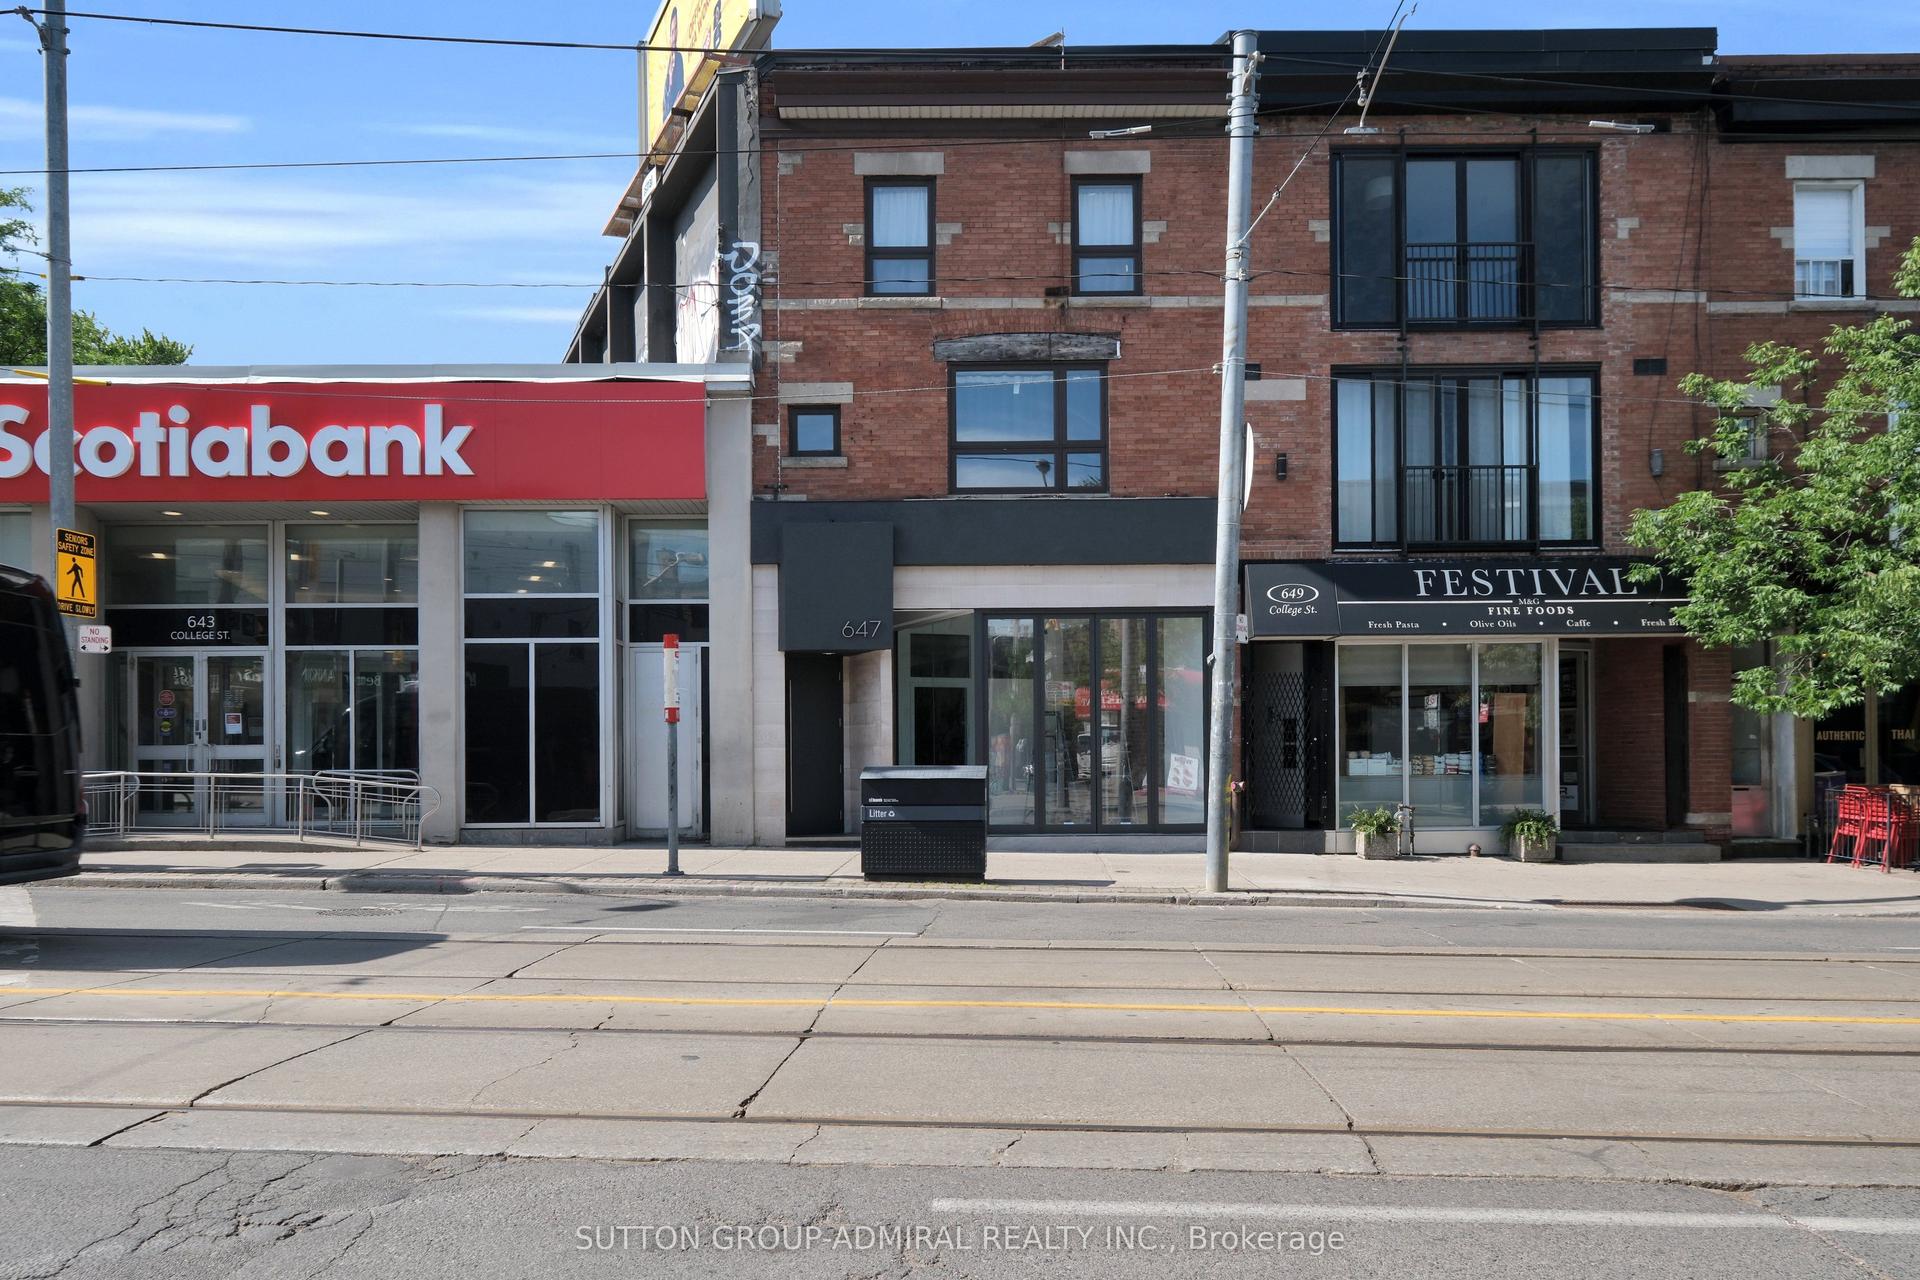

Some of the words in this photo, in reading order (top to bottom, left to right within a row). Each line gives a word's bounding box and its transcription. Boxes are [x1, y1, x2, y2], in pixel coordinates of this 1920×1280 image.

[64, 532, 88, 546] SENIORS
[57, 541, 79, 553] SAFETY
[80, 546, 95, 556] ZONE
[1413, 568, 1638, 596] FESTIVAL
[1281, 587, 1304, 599] 649
[57, 602, 73, 612] DRIVE
[75, 604, 95, 615] SLOWLY
[1269, 603, 1303, 617] College
[1303, 604, 1318, 615] St.
[1487, 606, 1521, 615] FINE
[1527, 606, 1574, 615] FOODS
[187, 615, 215, 628] 643
[1368, 620, 1393, 629] Fresh
[1395, 620, 1420, 629] Pasta
[1469, 619, 1495, 628] Olive
[1497, 619, 1517, 628] Oils
[1641, 618, 1666, 627] Fresh
[89, 628, 100, 636] NO
[841, 620, 882, 638] 647
[80, 636, 109, 644] STANDING
[170, 631, 215, 640] COLLEGE
[216, 631, 230, 640] ST.
[1816, 730, 1865, 741] AUTHENTIC
[1891, 728, 1915, 740] THAI
[869, 808, 888, 818] Litter
